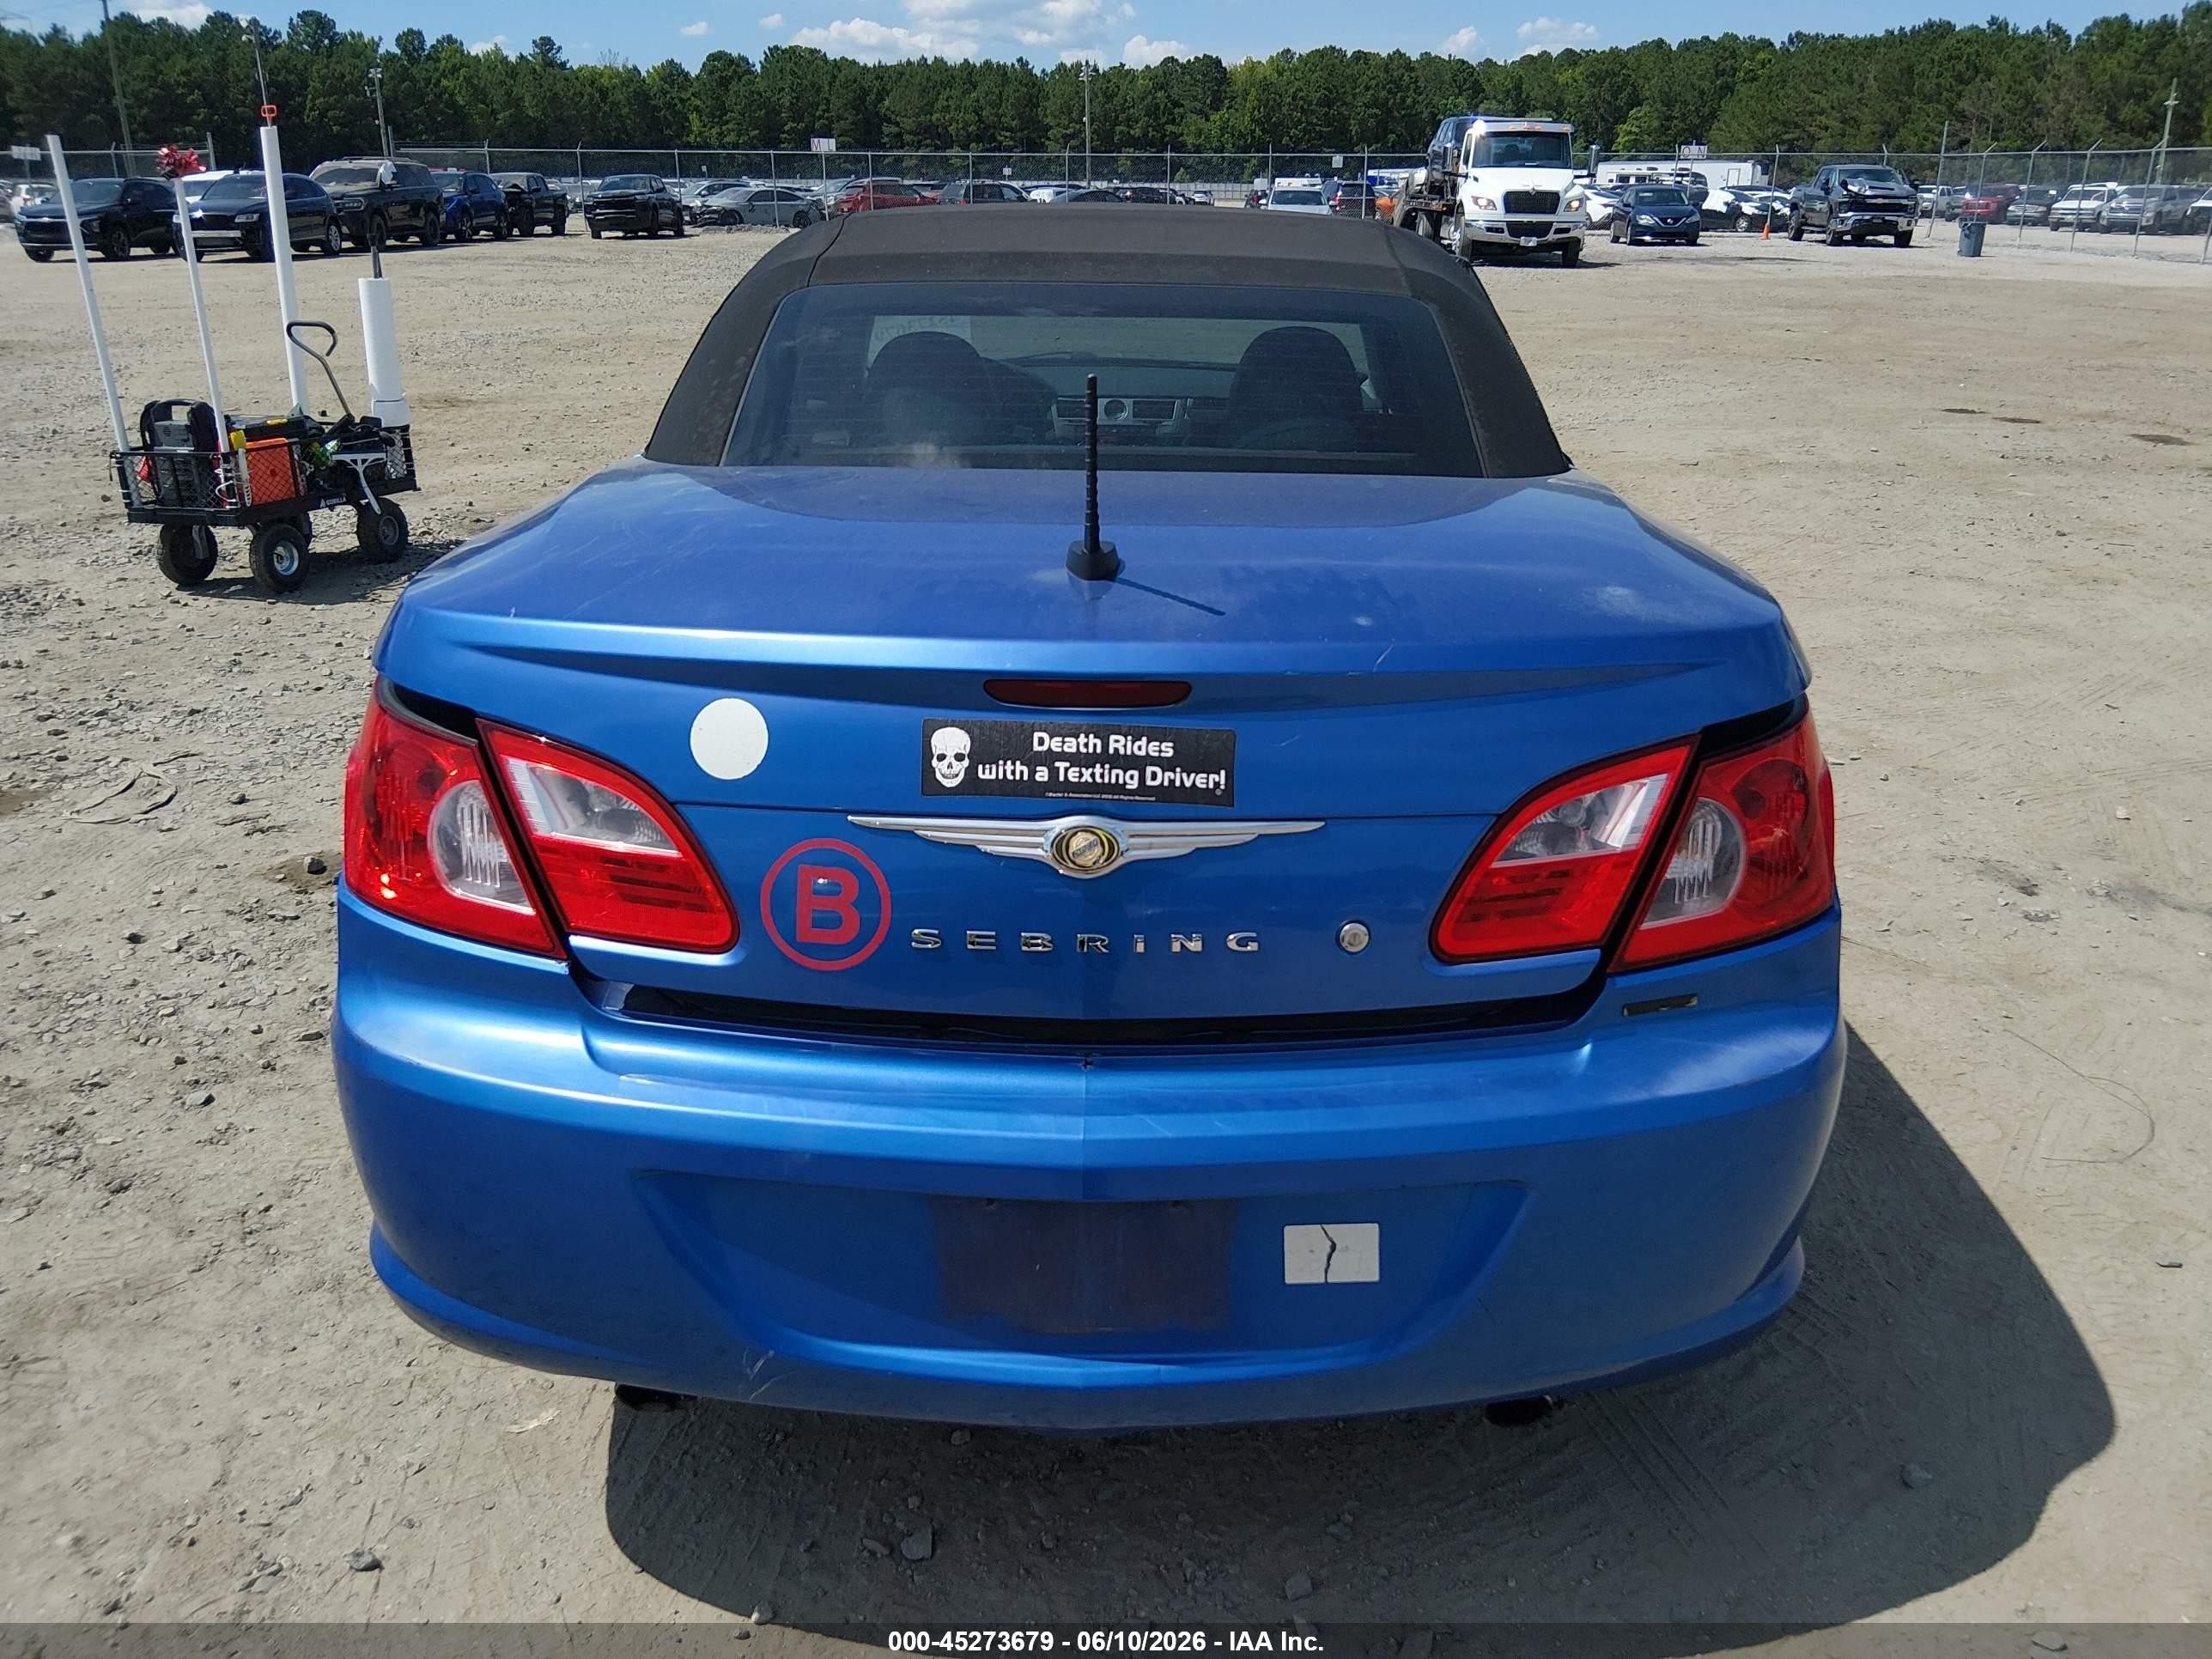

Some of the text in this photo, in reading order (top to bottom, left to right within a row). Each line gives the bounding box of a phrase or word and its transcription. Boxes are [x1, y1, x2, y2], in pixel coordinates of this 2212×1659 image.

[811, 138, 834, 151] M L
[1697, 146, 1705, 159] N
[1032, 731, 1174, 757] Death Rides
[977, 759, 1226, 790] with a Texting Driver!
[798, 865, 860, 944] B
[911, 928, 1260, 954] SEBRING
